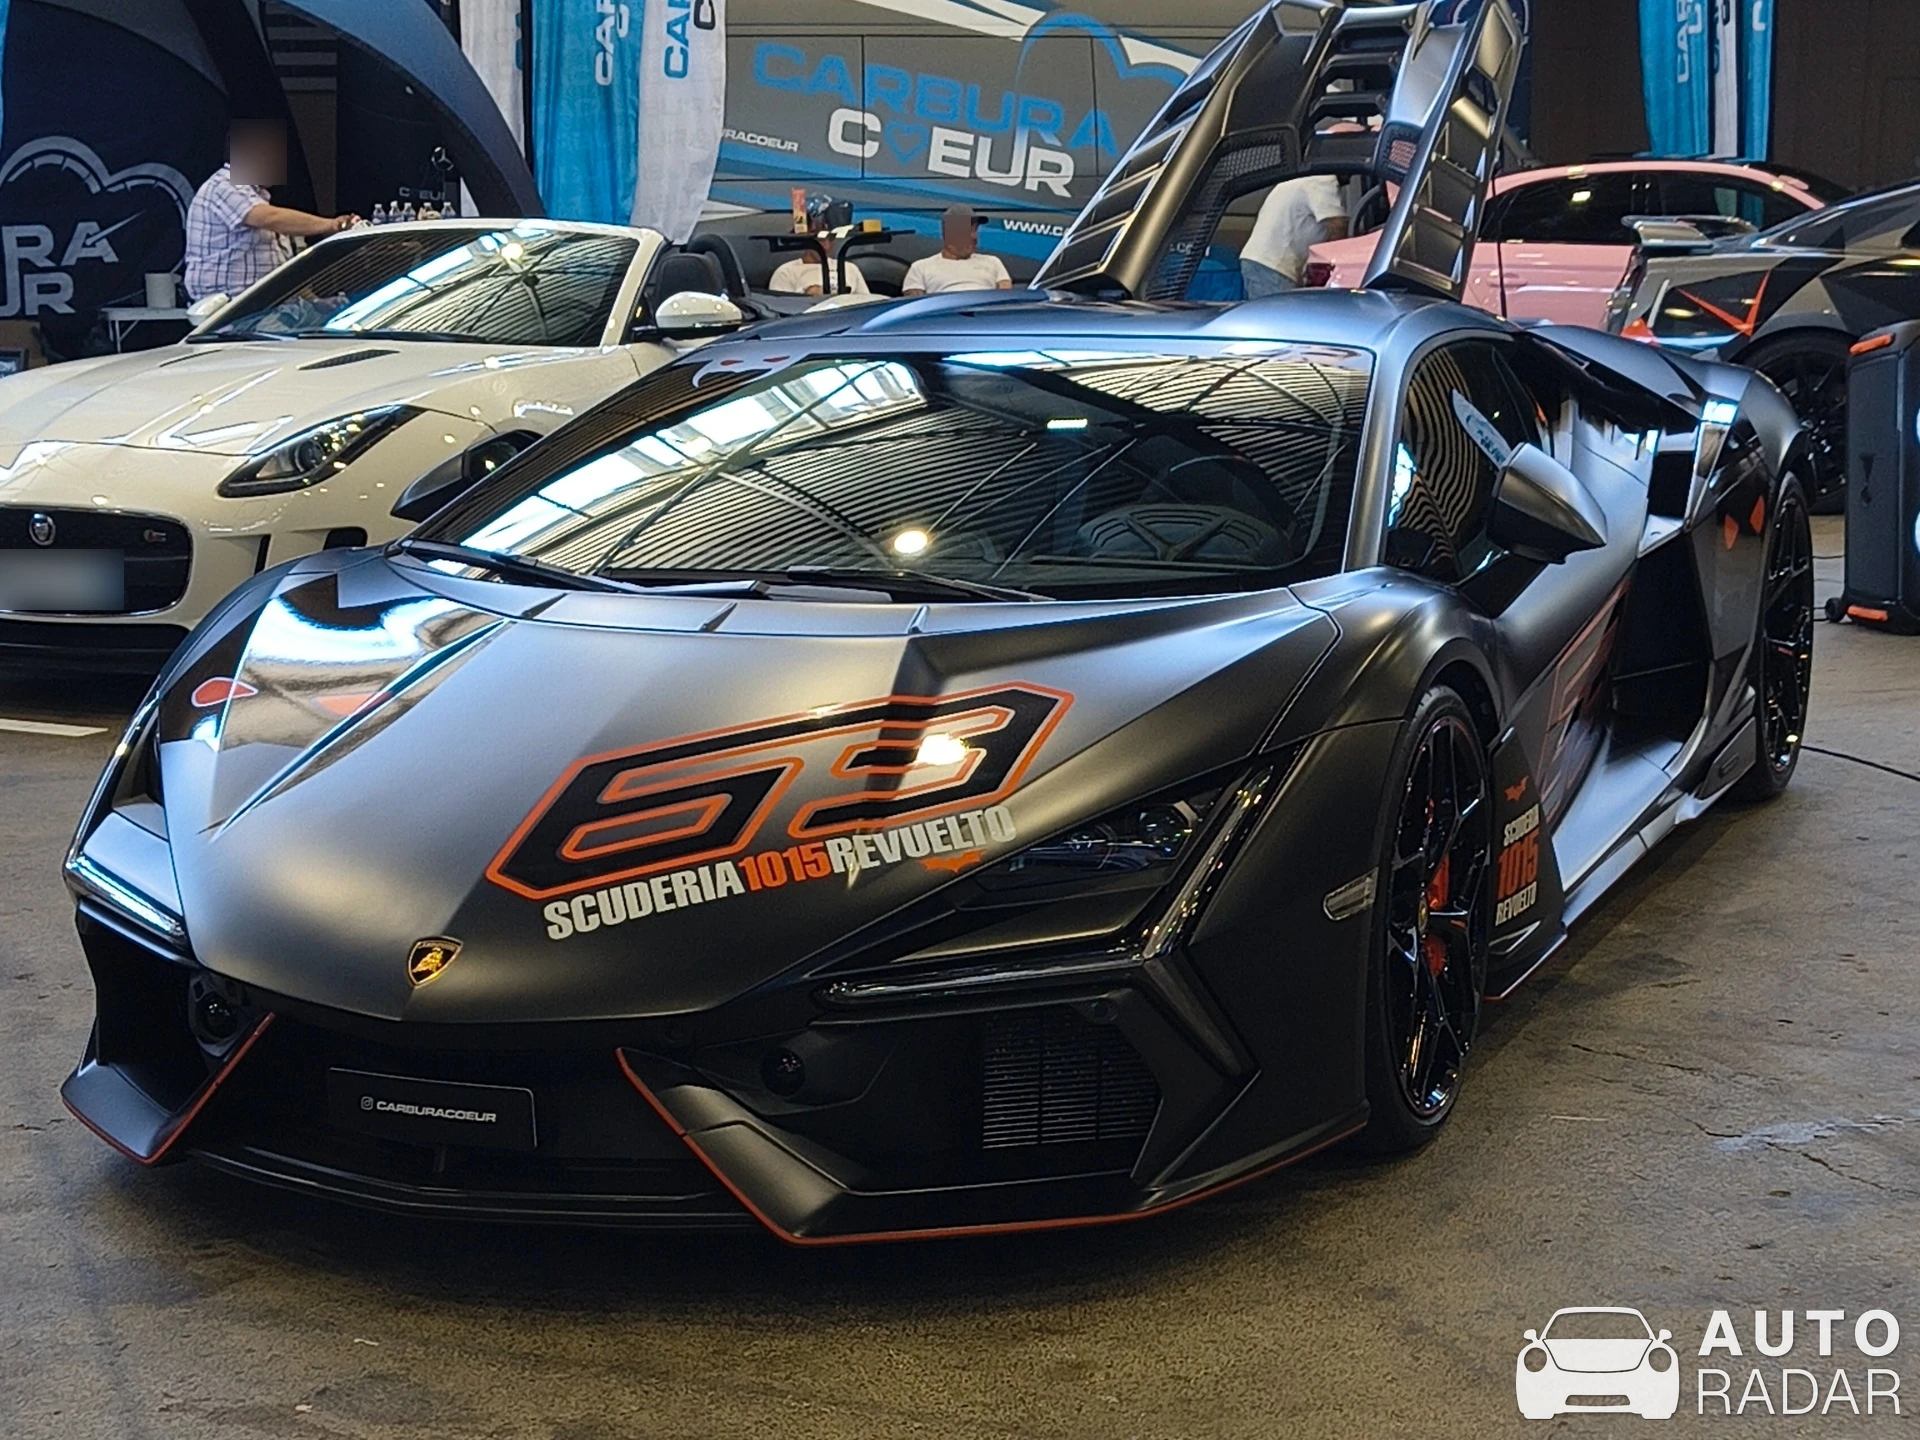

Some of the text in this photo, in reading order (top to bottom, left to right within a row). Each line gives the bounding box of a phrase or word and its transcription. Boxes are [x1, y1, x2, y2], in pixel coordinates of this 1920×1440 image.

[664, 0, 691, 79] CA
[753, 42, 1119, 157] CARBURA
[721, 128, 799, 152] RACOEUR
[738, 841, 832, 892] 1015
[376, 1100, 497, 1123] CARBURACOEUR
